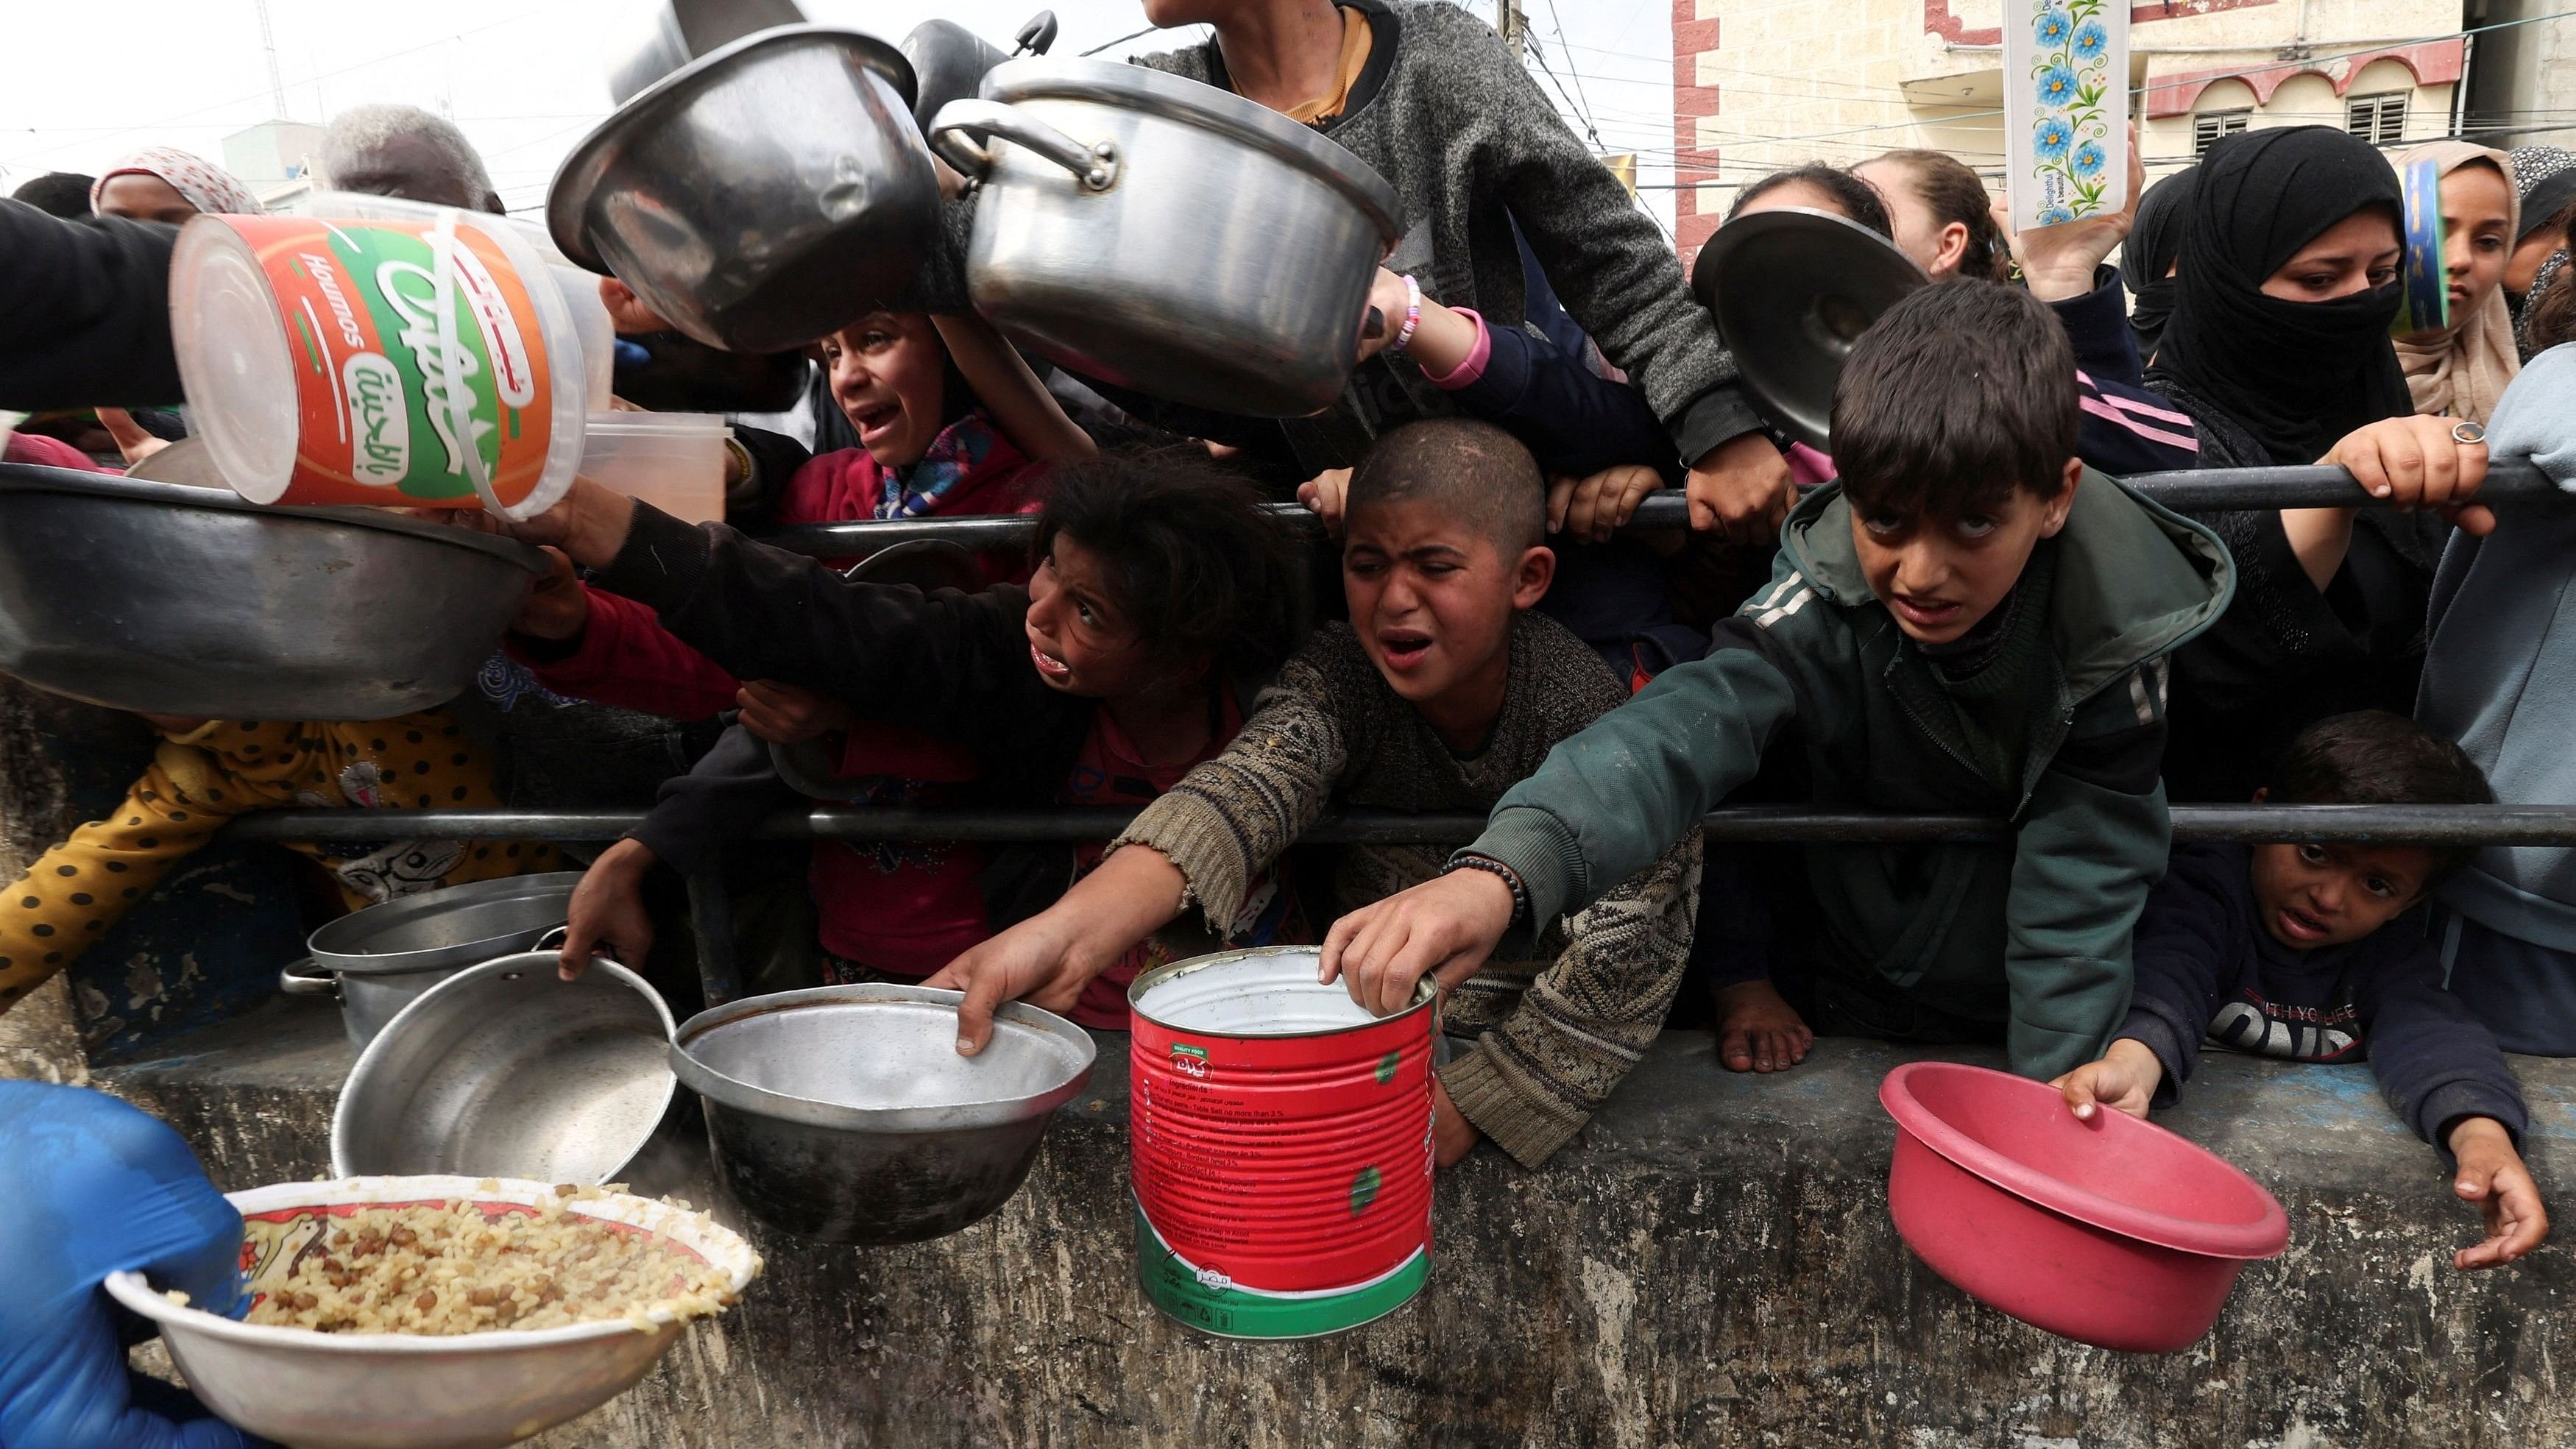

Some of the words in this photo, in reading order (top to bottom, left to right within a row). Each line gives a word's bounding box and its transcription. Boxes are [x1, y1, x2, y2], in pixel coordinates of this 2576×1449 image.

[2045, 174, 2054, 209] Delightful
[299, 252, 366, 350] Houmos
[351, 367, 403, 475] بالطحينة
[1170, 1078, 1208, 1094] Ingredients
[1210, 1107, 1223, 1115] Salt
[1179, 1162, 1209, 1176] Product
[1200, 1274, 1228, 1285] مصر
